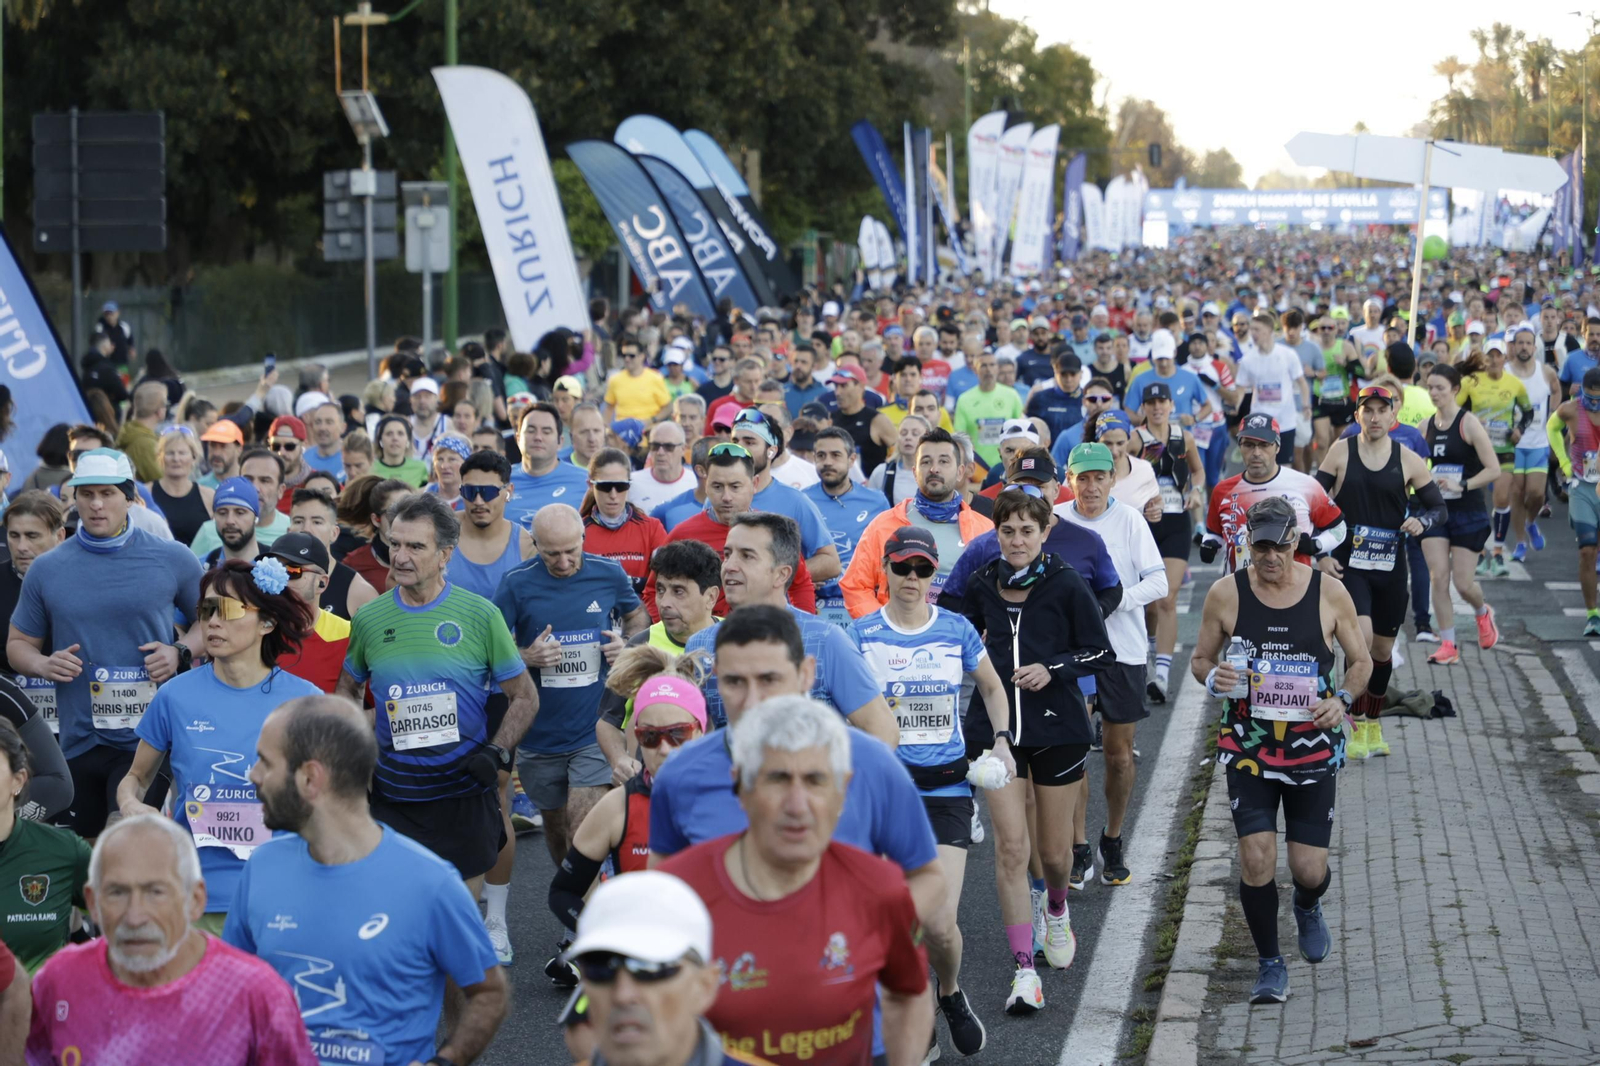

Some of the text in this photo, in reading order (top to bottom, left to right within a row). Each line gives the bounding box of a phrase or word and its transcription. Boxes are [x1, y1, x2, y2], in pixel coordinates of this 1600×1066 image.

[1314, 194, 1330, 208] DE
[1331, 194, 1379, 208] SEVILLA
[1371, 530, 1396, 538] ZURICH
[1350, 550, 1396, 562] JOSÉ CARLOS
[864, 624, 883, 635] HOKA
[560, 633, 593, 642] ZURICH
[1262, 642, 1290, 650] alma
[888, 658, 908, 666] LUSO
[1262, 652, 1316, 662] fit&healthy
[555, 661, 587, 674] NONO
[1274, 664, 1310, 674] ZURICH
[113, 670, 149, 680] ZURIH
[406, 682, 446, 694] ZURICH
[910, 684, 948, 694] ZURICH
[1274, 682, 1294, 690] 8235
[112, 689, 137, 698] 11400
[1256, 692, 1310, 706] PAPIJAVI
[92, 703, 122, 714] CHRIS
[406, 703, 433, 714] 10745
[908, 703, 934, 712] 12231
[390, 712, 456, 734] CARRASCO
[216, 812, 240, 822] 9921
[7, 912, 57, 922] PATRICIA RAMOS
[312, 1042, 371, 1062] ZURICH
